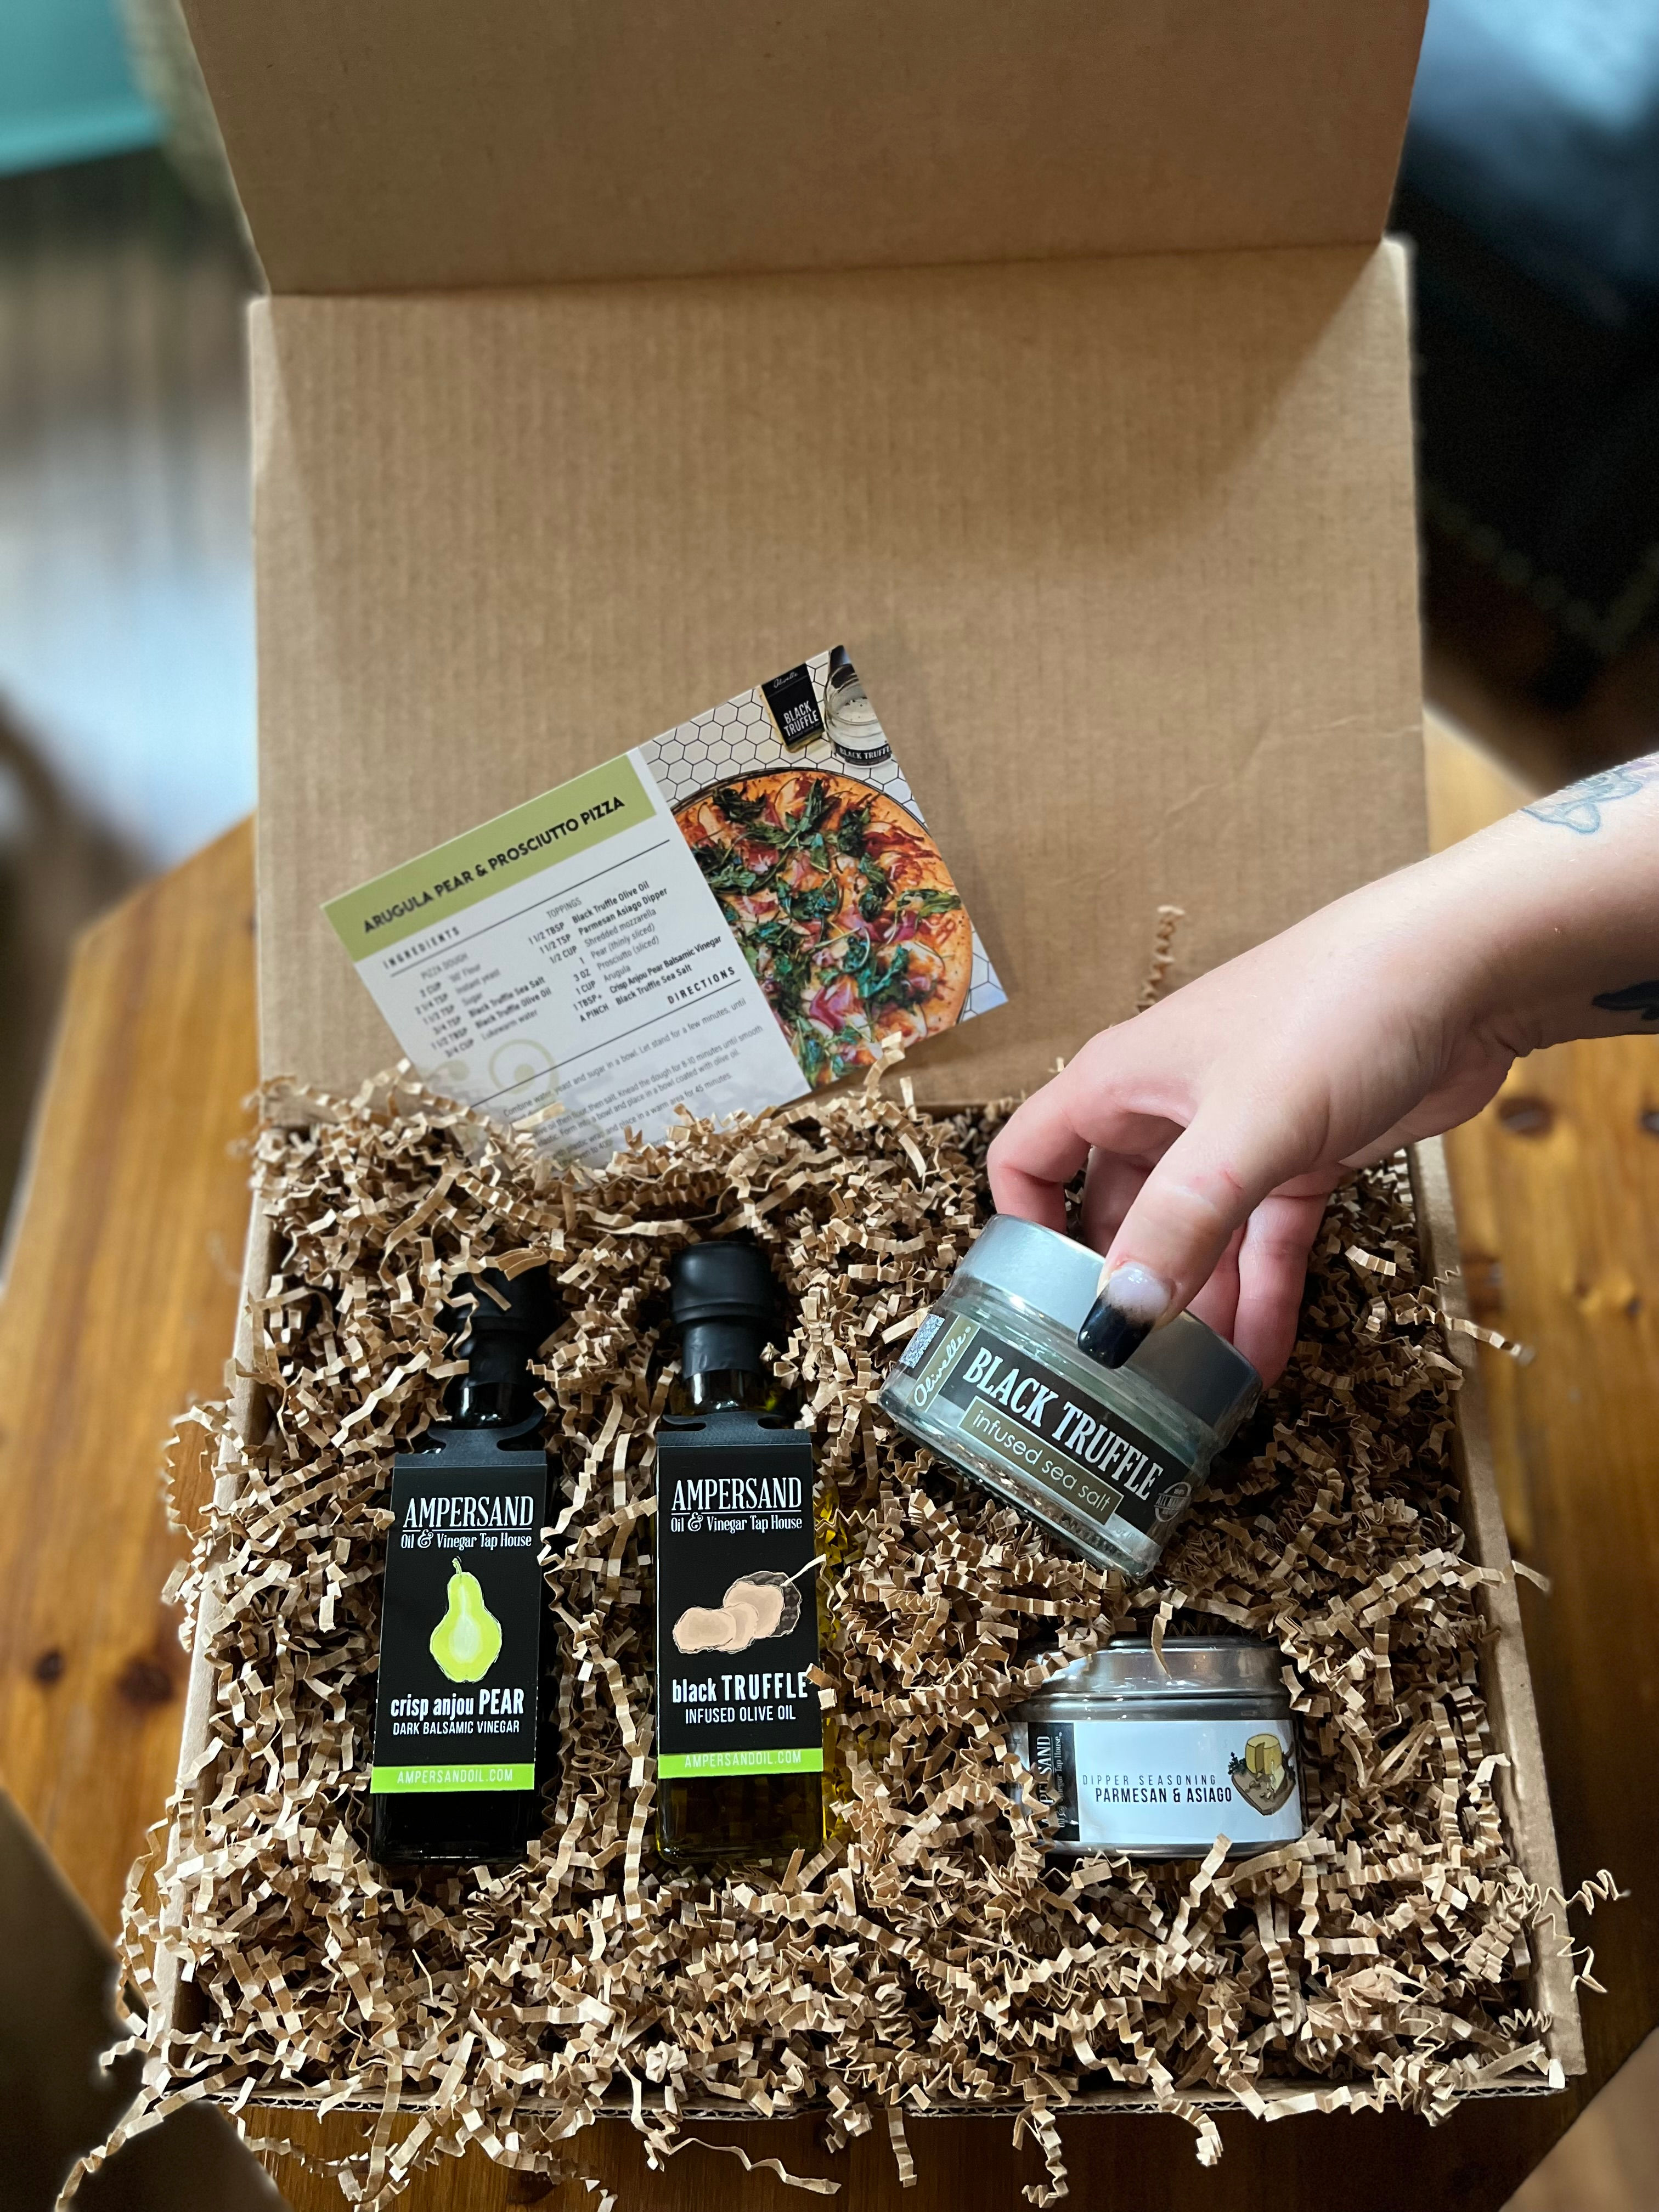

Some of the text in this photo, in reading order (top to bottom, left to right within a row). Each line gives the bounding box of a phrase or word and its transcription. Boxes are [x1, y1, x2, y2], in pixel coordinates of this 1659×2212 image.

[783, 701, 811, 724] BLACK
[783, 710, 819, 737] TRUFFLE
[839, 746, 862, 759] BLACK
[361, 794, 625, 934] ARUGULA PEAR & PROSCIUTTO PIZZA
[533, 931, 546, 943] 1/2
[545, 921, 566, 936] TBSP
[572, 908, 594, 924] Black
[592, 895, 618, 914] Truffle
[617, 886, 638, 902] Olive
[637, 880, 650, 891] Oil
[544, 940, 557, 952] 1/2
[556, 933, 572, 946] TSP
[578, 912, 616, 936] Parmesan
[616, 899, 643, 919] Asiago
[642, 887, 669, 906] Dipper
[546, 896, 582, 919] TOPPINGS
[382, 925, 460, 970] INGREDIENTS
[549, 907, 657, 964] 1/2 CUP Shredded mozzarella
[590, 946, 608, 960] Pear
[607, 934, 631, 952] (thinly
[630, 922, 656, 941] sliced)
[573, 934, 661, 982] 3 OZ Prosciutto (sliced)
[578, 991, 603, 1009] TBSP+
[608, 979, 629, 995] Crisp
[627, 970, 648, 987] Anjou
[647, 962, 664, 976] Pear
[663, 946, 696, 968] Balsamic
[694, 934, 723, 955] Vinegar
[513, 983, 529, 996] Sea
[529, 975, 545, 989] Salt
[579, 963, 692, 1023] A PINCH Black Truffle Sea Salt
[580, 979, 597, 993] CUP
[602, 963, 631, 984] Arugula
[667, 964, 735, 1005] DIRECTIONS
[520, 992, 540, 1007] Olive
[539, 986, 552, 997] Oil
[518, 1008, 538, 1023] water
[503, 1098, 533, 1118] Combine
[554, 1080, 573, 1095] yeast
[572, 1073, 586, 1085] and
[586, 1064, 606, 1080] sugar
[606, 1060, 614, 1069] in
[638, 1042, 651, 1054] Let
[650, 1033, 671, 1048] stand
[670, 1028, 681, 1039] for
[686, 1018, 701, 1031] few
[701, 1005, 731, 1025] minutes,
[730, 997, 747, 1011] until
[556, 1113, 572, 1126] then
[588, 1098, 604, 1111] then
[617, 1082, 639, 1098] Knead
[638, 1077, 651, 1088] the
[650, 1067, 673, 1084] dough
[671, 1063, 682, 1073] for
[681, 1056, 696, 1068] 8-10
[695, 1043, 723, 1062] minutes
[721, 1036, 738, 1049] until
[737, 1024, 763, 1042] smooth
[560, 1123, 577, 1137] Form
[596, 1107, 613, 1120] bowl
[612, 1101, 627, 1113] and
[626, 1092, 645, 1107] place
[645, 1088, 652, 1097] in
[657, 1077, 675, 1092] bowl
[674, 1067, 698, 1084] coated
[697, 1060, 713, 1073] with
[713, 1052, 730, 1066] olive
[605, 1123, 619, 1135] and
[618, 1114, 637, 1130] place
[636, 1111, 645, 1120] in
[650, 1101, 669, 1114] warm
[669, 1094, 685, 1105] area
[684, 1087, 695, 1098] for
[693, 1084, 704, 1093] 45
[913, 1331, 968, 1407] Olivelle
[962, 1347, 1165, 1502] BLACK TRUFFLE
[972, 1409, 1110, 1513] infused sea salt
[672, 1477, 802, 1511] AMPERSAND
[403, 1496, 534, 1528] AMPERSAND
[670, 1511, 802, 1534] Oil & Vinegar Tap House
[401, 1529, 532, 1551] Oil & Vinegar Tap House
[673, 1672, 808, 1703] black TRUFFLE
[391, 1688, 524, 1721] crisp anjou PEAR
[686, 1705, 796, 1724] INFUSED OLIVE OIL
[393, 1720, 520, 1735] DARK BALSAMIC VINEGAR
[685, 1750, 801, 1768] AMPERSANDOIL.COM
[1054, 1736, 1063, 1758] House
[397, 1768, 513, 1784] AMPERSANDOIL.COM
[1054, 1759, 1063, 1773] Tap
[1083, 1775, 1216, 1785] DIPPER SEASONING
[1096, 1787, 1232, 1802] PARMESAN & ASIAGO
